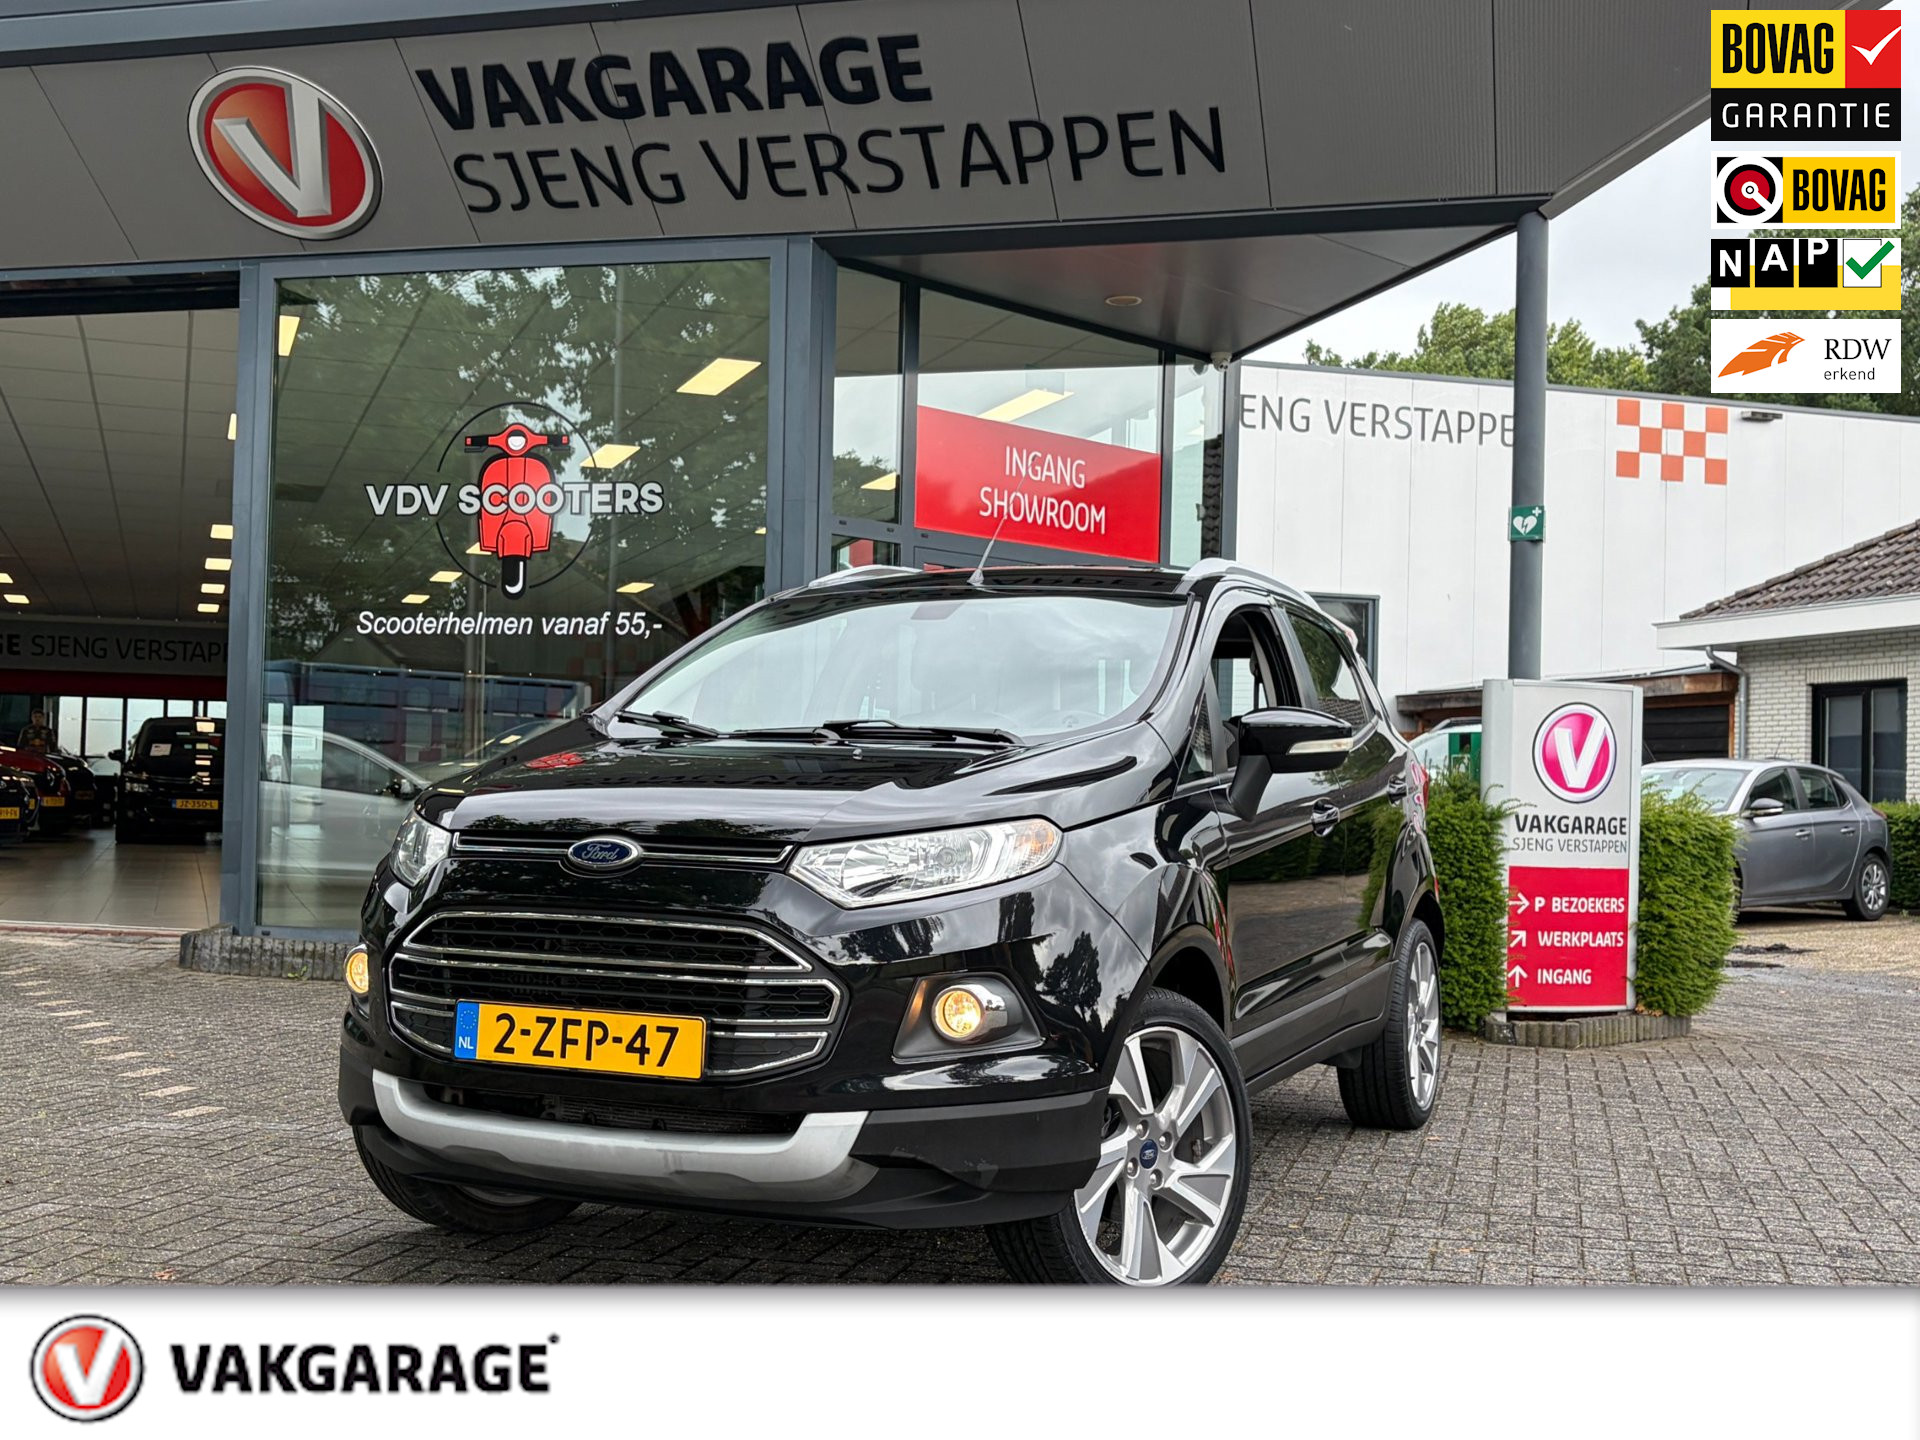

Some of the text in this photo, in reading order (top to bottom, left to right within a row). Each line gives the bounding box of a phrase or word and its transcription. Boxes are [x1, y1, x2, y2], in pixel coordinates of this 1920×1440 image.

[416, 34, 933, 131] VAKGARAGE
[452, 106, 1226, 214] SJENG VERSTAPPEN
[1005, 445, 1086, 489] INGANG
[365, 482, 664, 516] VDV SCOOTERS
[979, 486, 1106, 535] SHOWROOM
[356, 611, 662, 639] Scooterhelmen vanaf 55,-
[31, 635, 108, 660] SJENG
[1515, 814, 1627, 835] VAKGARAGE
[582, 843, 620, 860] Ford
[1513, 837, 1627, 853] SJENG VERSTAPPEN
[1534, 897, 1625, 913] P BEZOEKERS
[1538, 931, 1624, 947] WERKPLAATS
[1537, 969, 1592, 985] INGANG
[458, 1036, 474, 1050] NL
[493, 1013, 680, 1068] 2-ZFP-47
